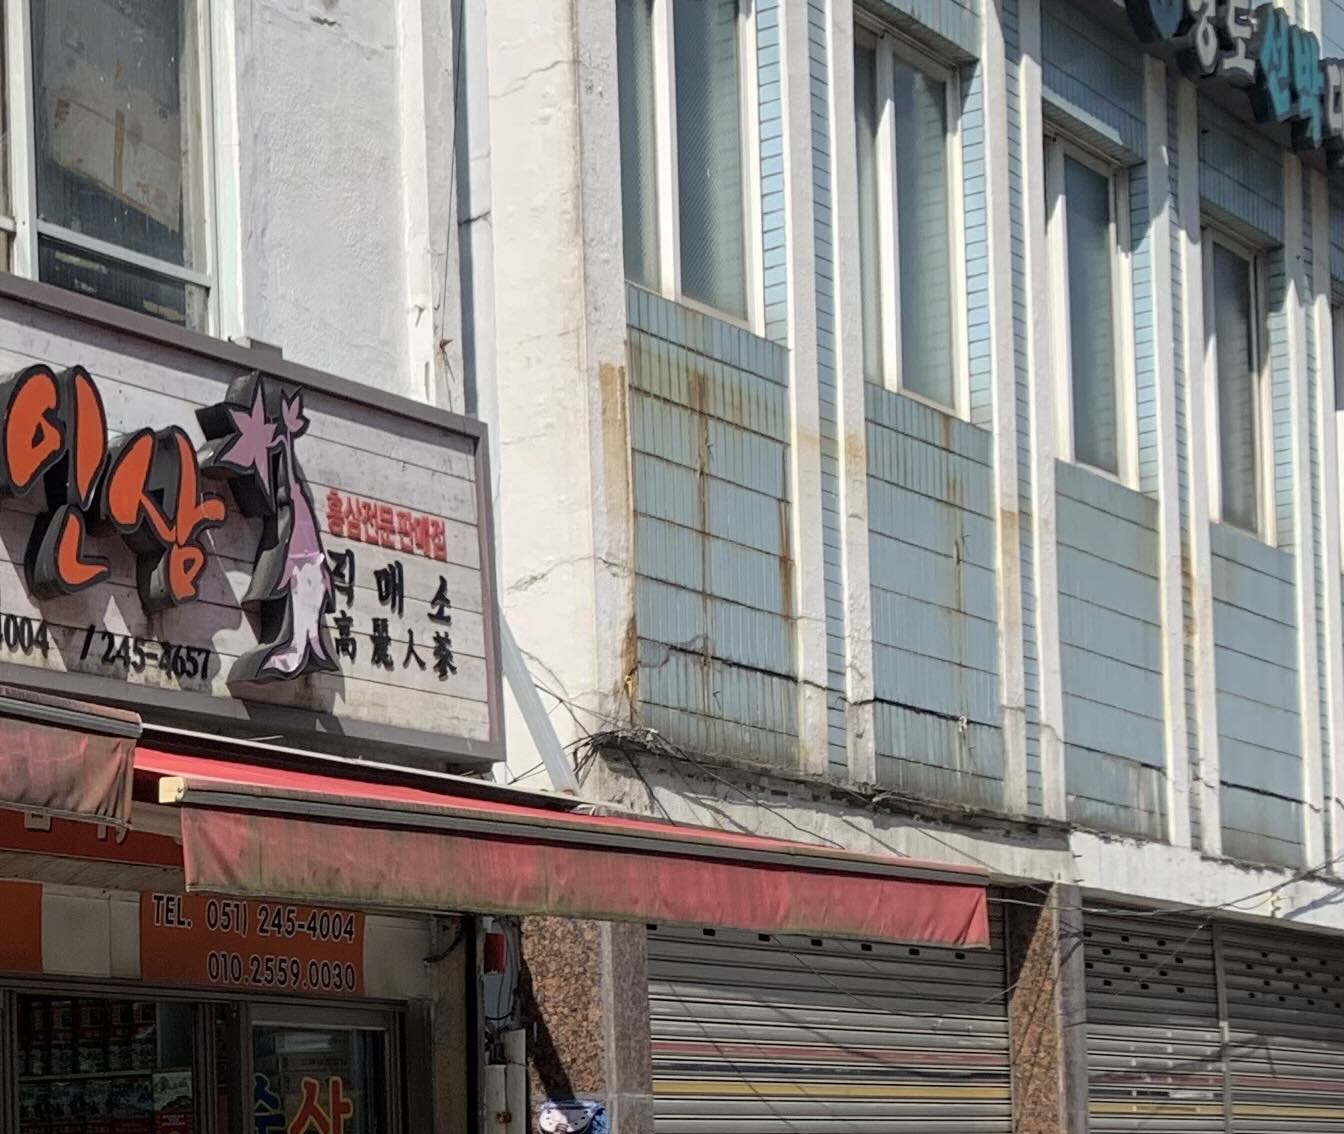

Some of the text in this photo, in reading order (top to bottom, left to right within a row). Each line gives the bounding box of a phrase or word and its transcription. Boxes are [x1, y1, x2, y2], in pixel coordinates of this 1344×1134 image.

[151, 894, 356, 945] TEL. 051) 245-4004
[207, 951, 357, 993] 010.2559.0030
